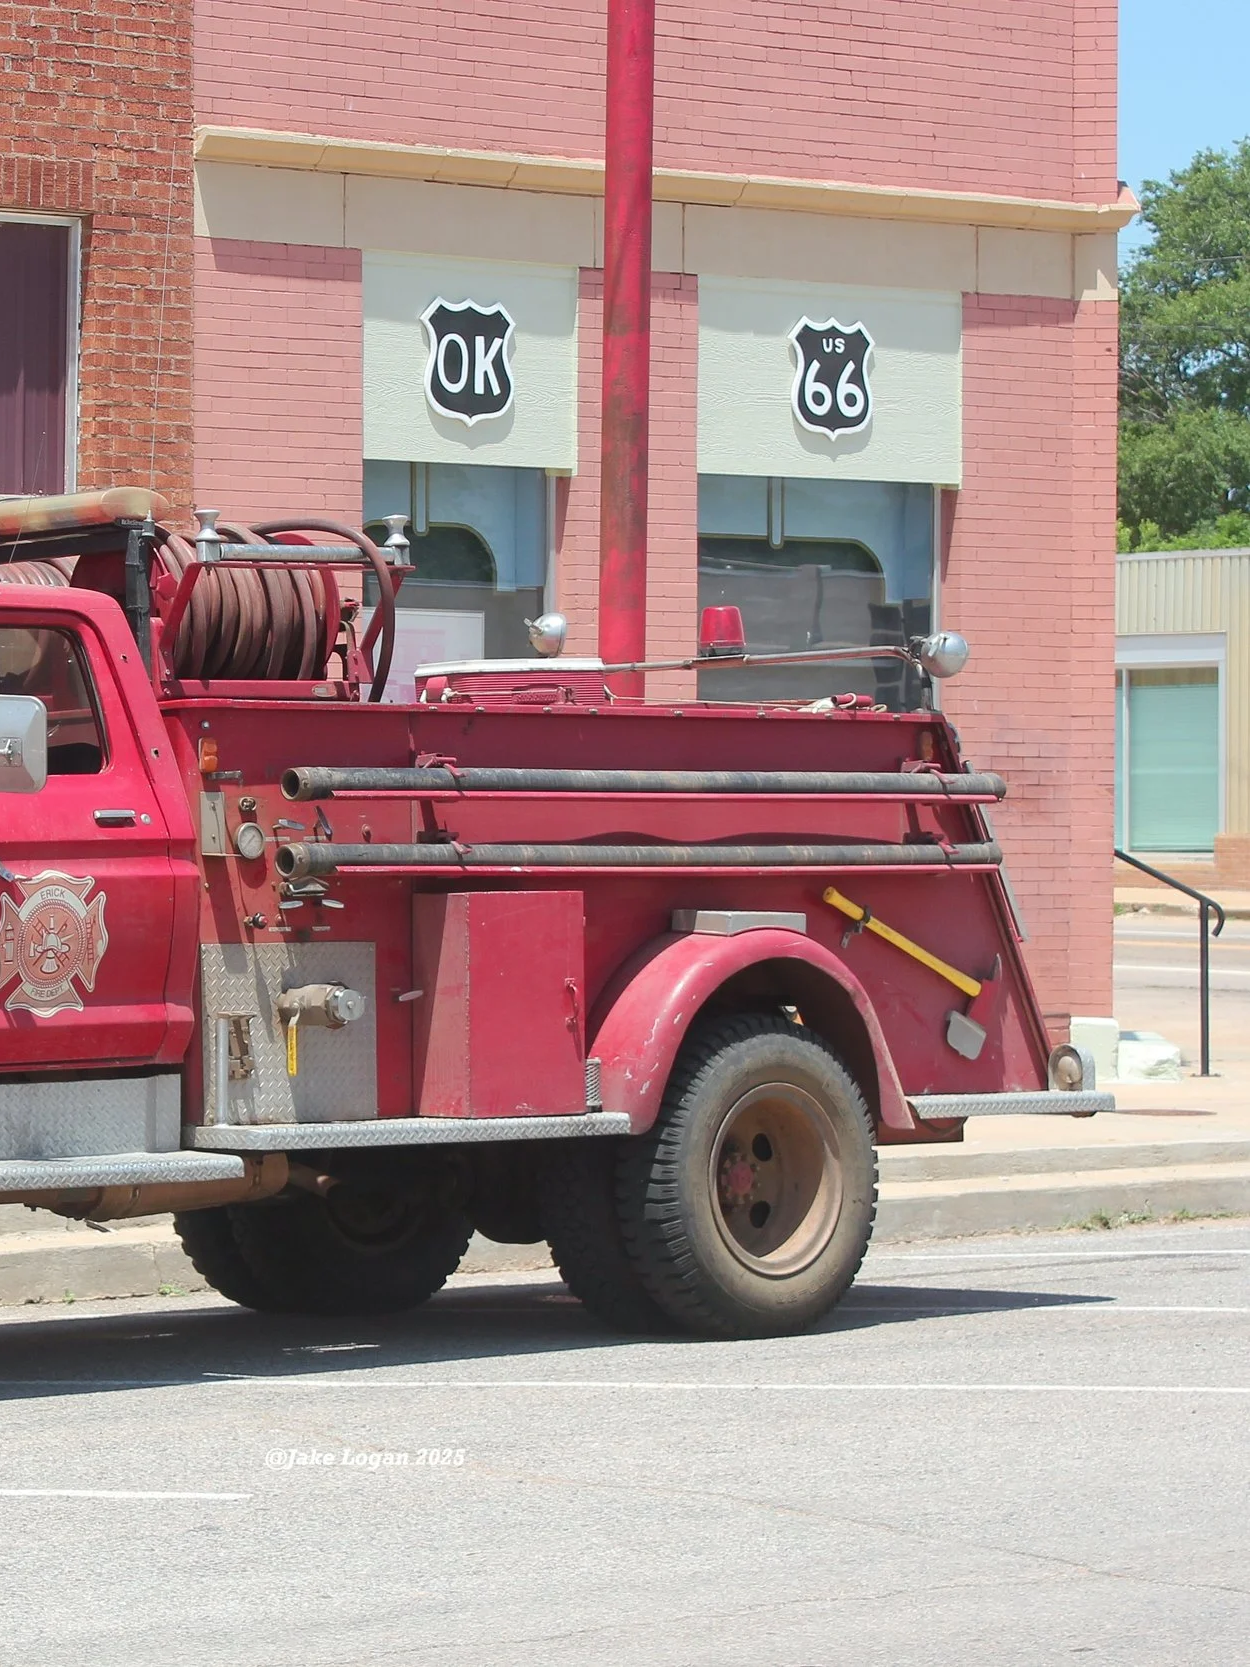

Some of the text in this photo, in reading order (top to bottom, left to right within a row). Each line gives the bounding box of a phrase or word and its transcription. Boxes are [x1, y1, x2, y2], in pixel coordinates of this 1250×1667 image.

[437, 332, 504, 396] OK
[821, 337, 846, 355] US
[804, 358, 863, 417] 66
[39, 887, 66, 901] ERICK
